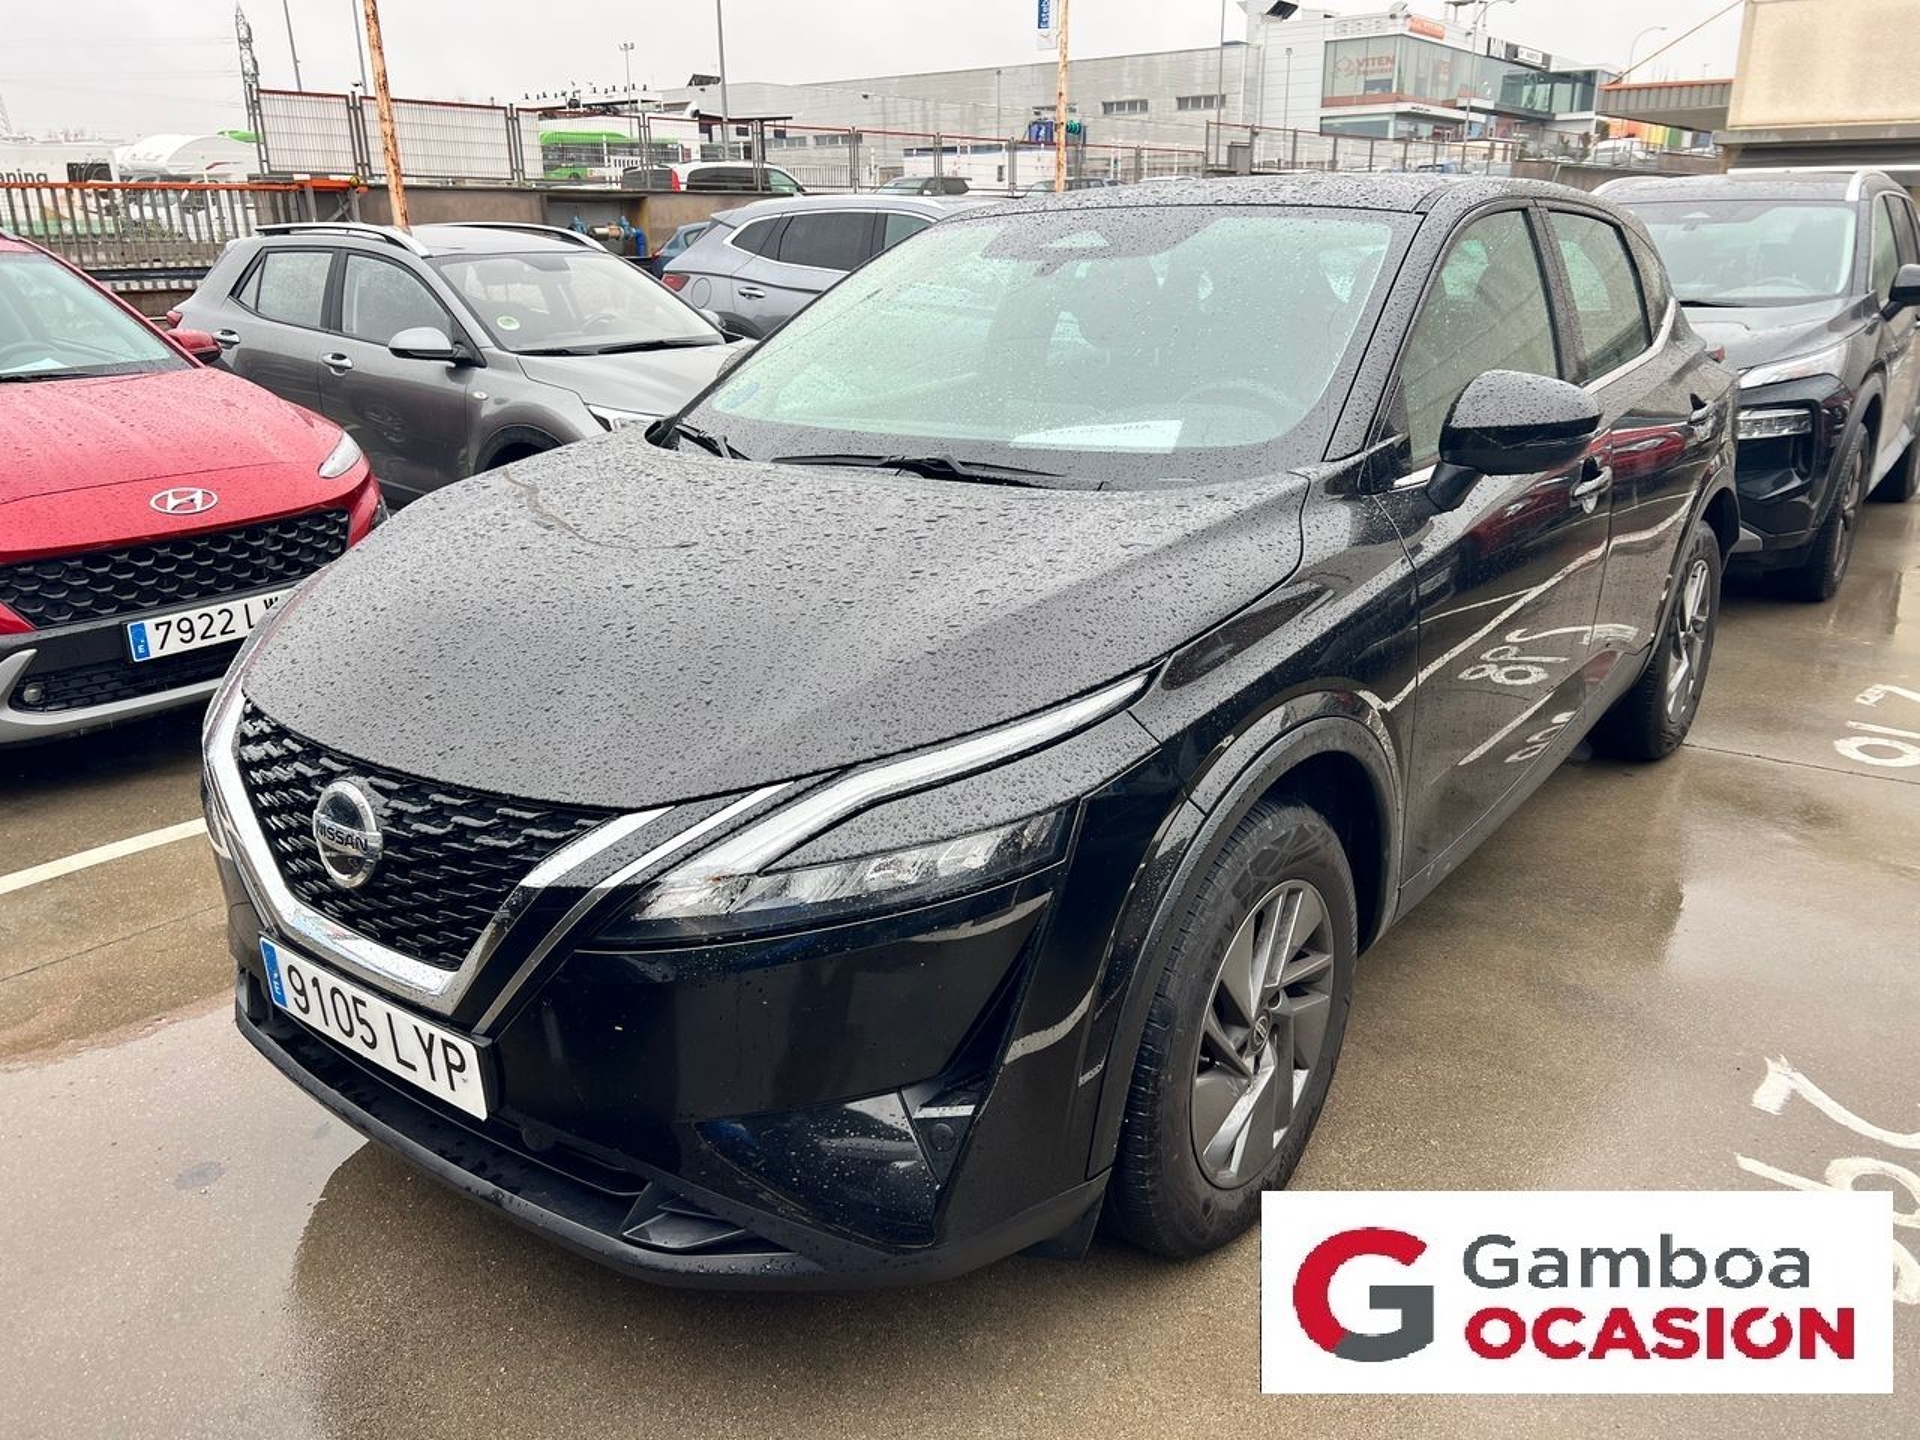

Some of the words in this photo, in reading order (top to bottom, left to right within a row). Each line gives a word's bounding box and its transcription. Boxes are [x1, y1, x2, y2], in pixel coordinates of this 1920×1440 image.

[155, 608, 236, 650] 7922
[318, 821, 369, 852] NISSAN
[287, 963, 378, 1050] 9105
[386, 1011, 467, 1092] LYP
